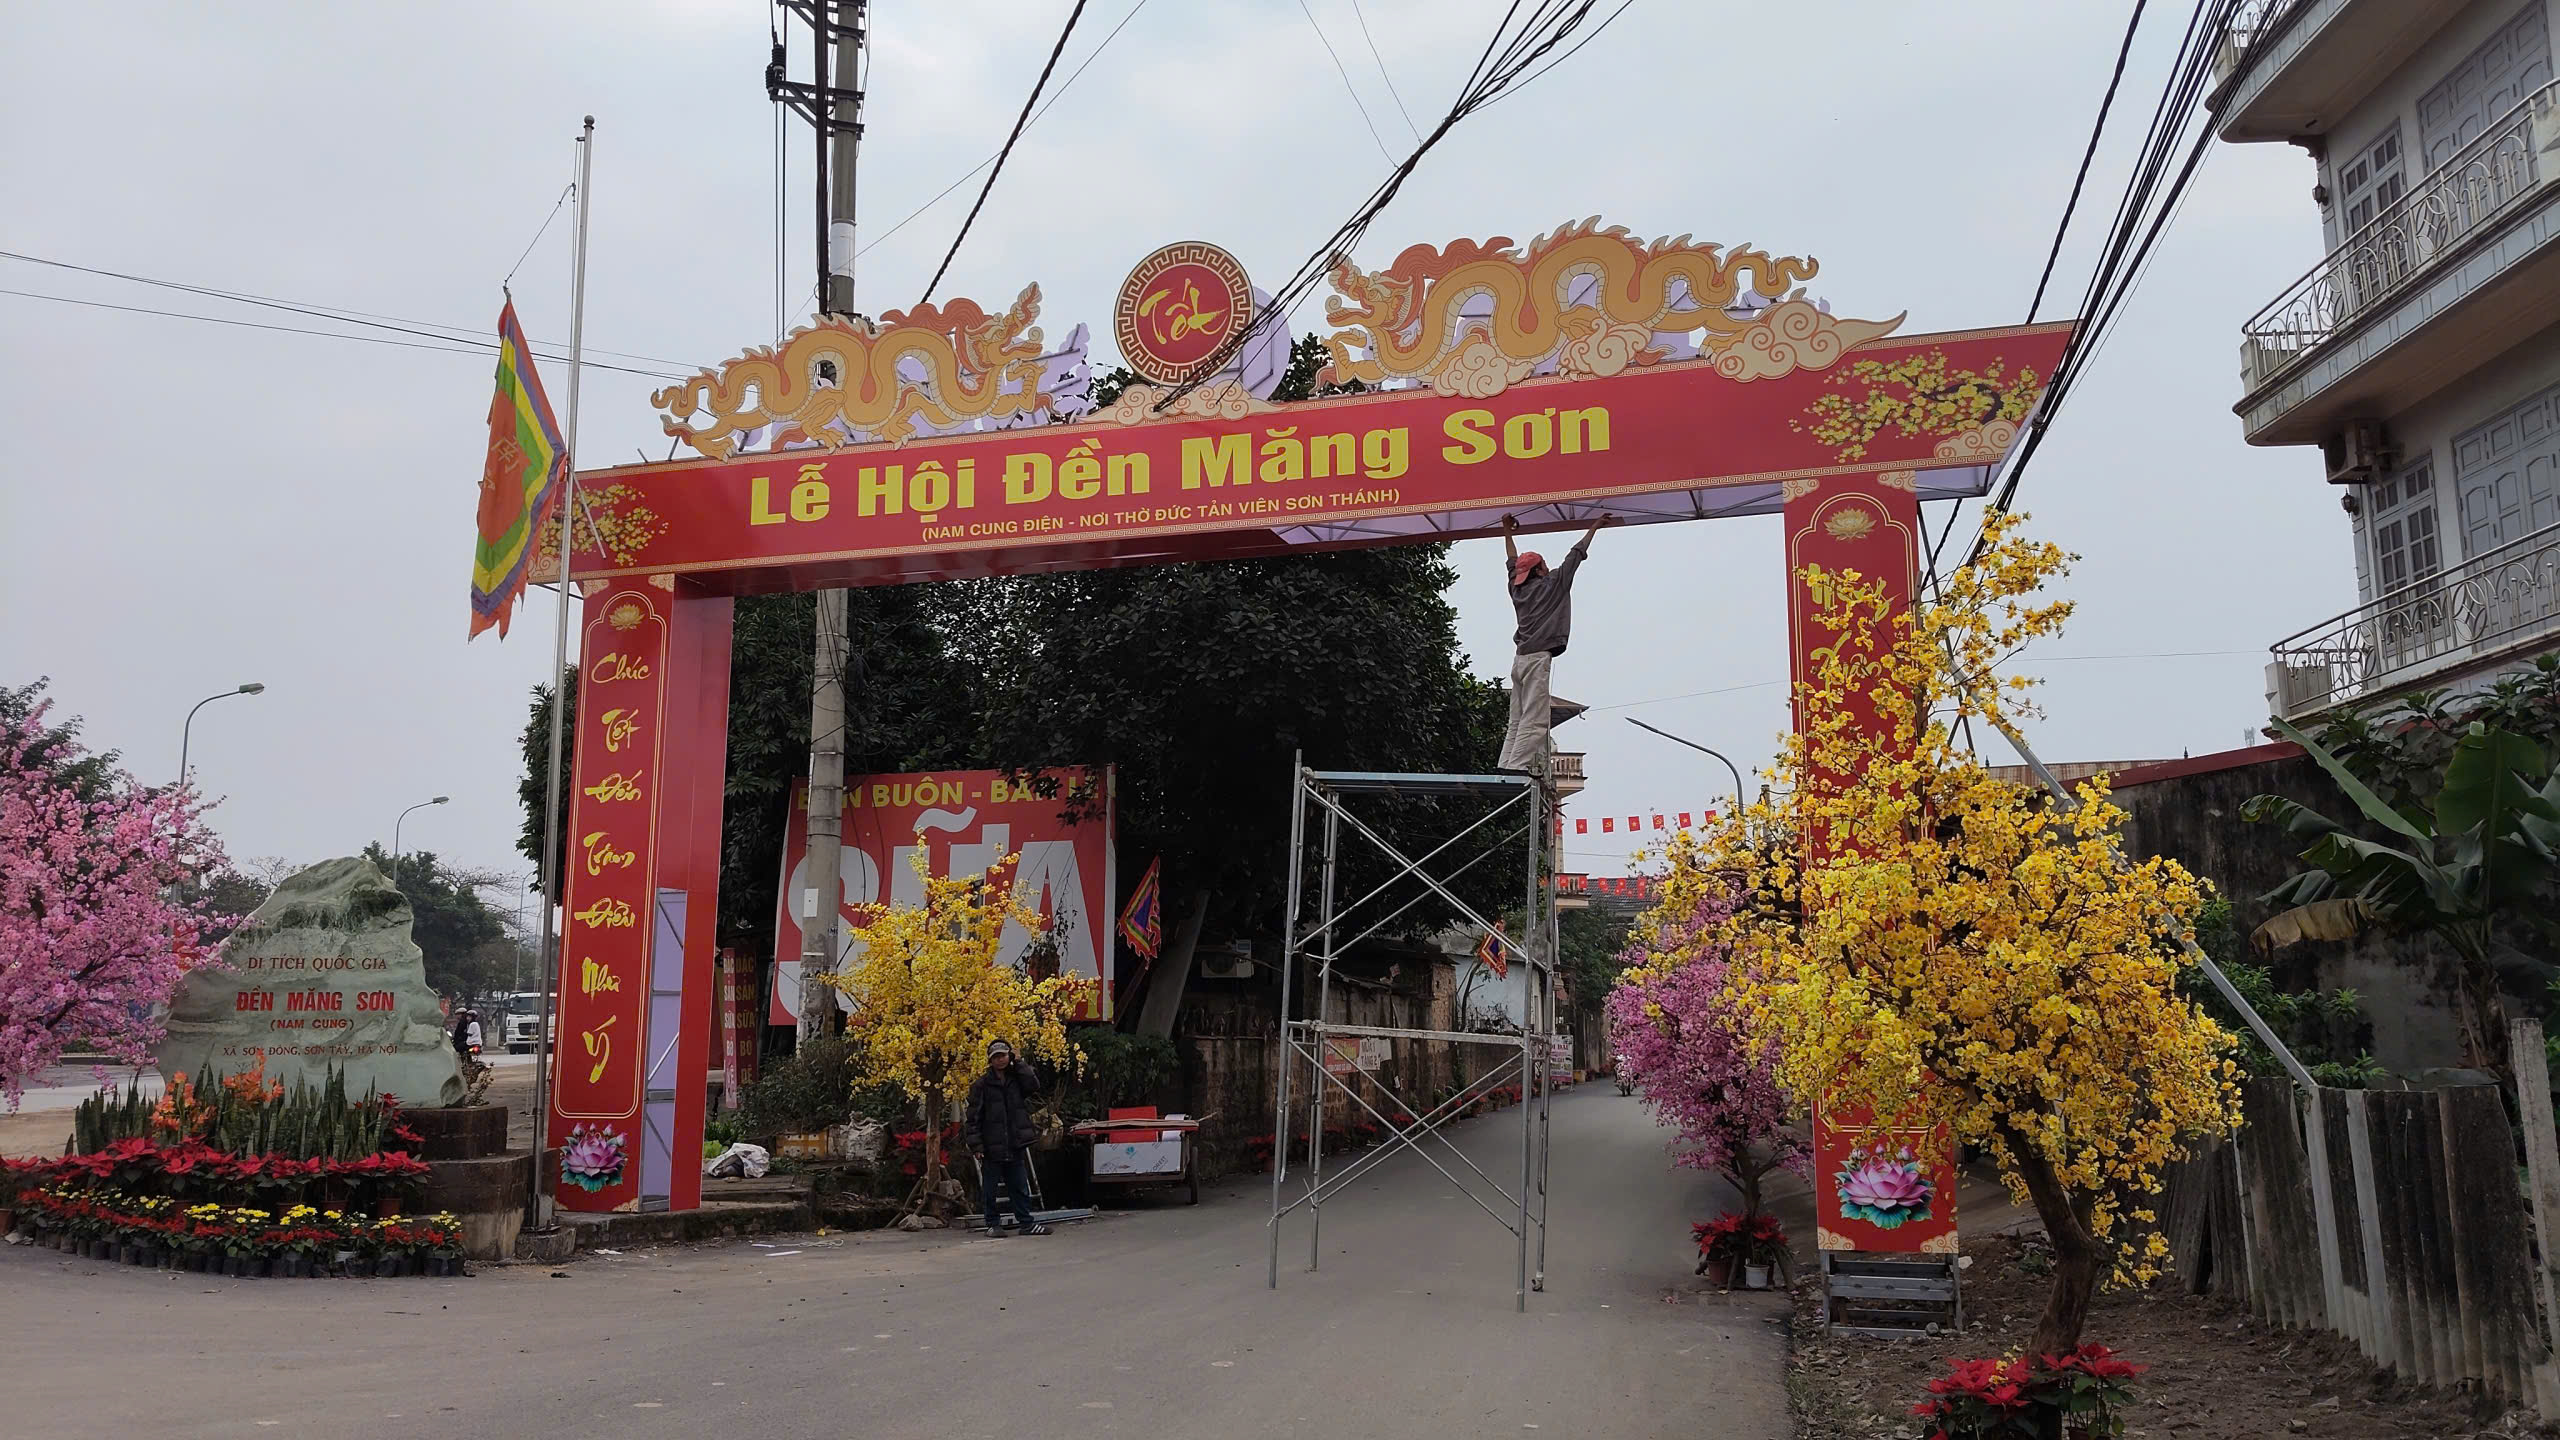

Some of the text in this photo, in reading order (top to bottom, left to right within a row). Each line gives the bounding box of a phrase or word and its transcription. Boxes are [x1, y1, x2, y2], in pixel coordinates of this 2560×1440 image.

[750, 405, 1610, 526] Lễ Hội Đền Măng Sơn
[922, 526, 964, 543] (NAM
[969, 521, 1018, 536] CUNG
[1023, 515, 1064, 532] ĐIỆN
[1079, 512, 1109, 527] NƠI
[1114, 508, 1151, 525] THỜ
[1154, 504, 1192, 521] ĐỨC
[1197, 499, 1232, 517] TẢN
[1239, 496, 1280, 513] VIÊN
[1285, 493, 1323, 510] SƠN
[1329, 488, 1400, 506] THÁNH)
[591, 652, 651, 684] Chúc
[601, 708, 642, 753] Tết
[584, 769, 643, 803] Đến
[798, 786, 862, 811] BN
[872, 776, 964, 807] BUÔN
[248, 952, 387, 972] DI TÍCH QUỐC GIA
[236, 985, 395, 1012] ĐỀN MĂNG SƠN
[270, 1018, 354, 1032] (NAM CUNG)
[223, 1045, 237, 1056] XÃ
[304, 1044, 325, 1056] SƠN
[379, 1043, 398, 1057] NỘI
[582, 1014, 617, 1084] Ý
